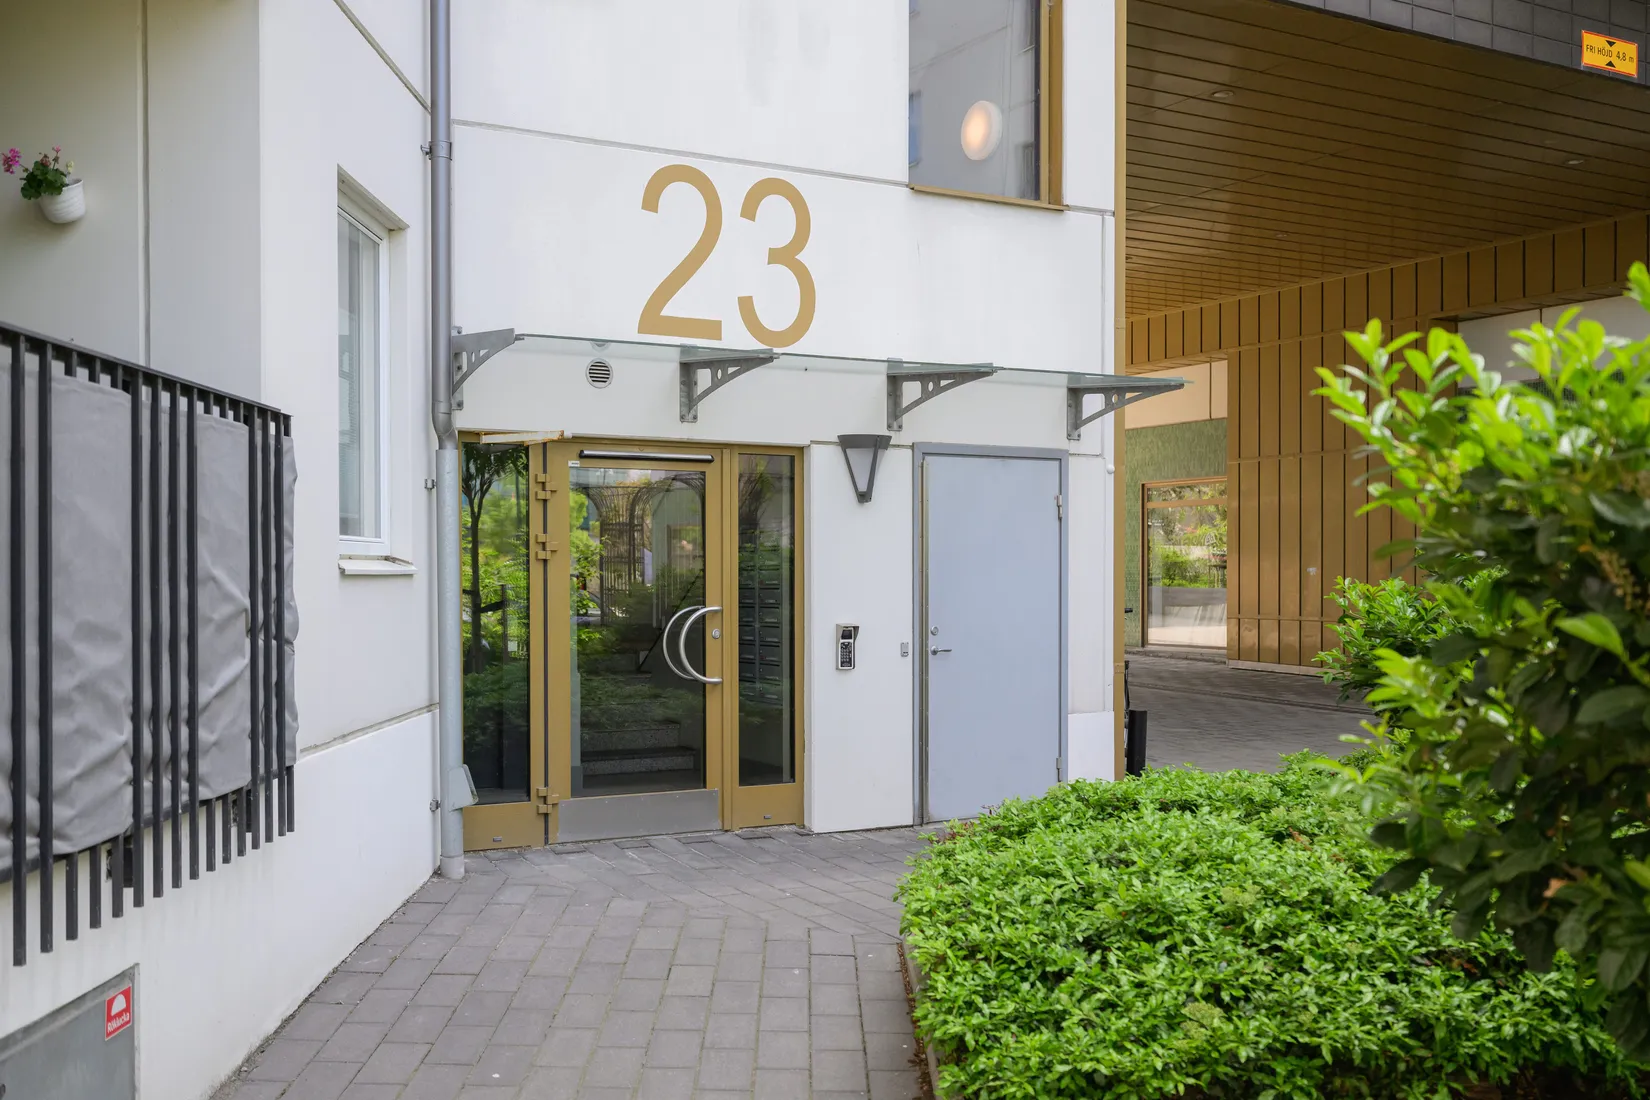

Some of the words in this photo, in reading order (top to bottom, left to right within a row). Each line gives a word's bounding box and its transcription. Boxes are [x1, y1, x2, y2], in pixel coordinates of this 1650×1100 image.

[1586, 44, 1596, 54] FRI
[1597, 46, 1613, 58] HÖJD
[638, 164, 816, 348] 23
